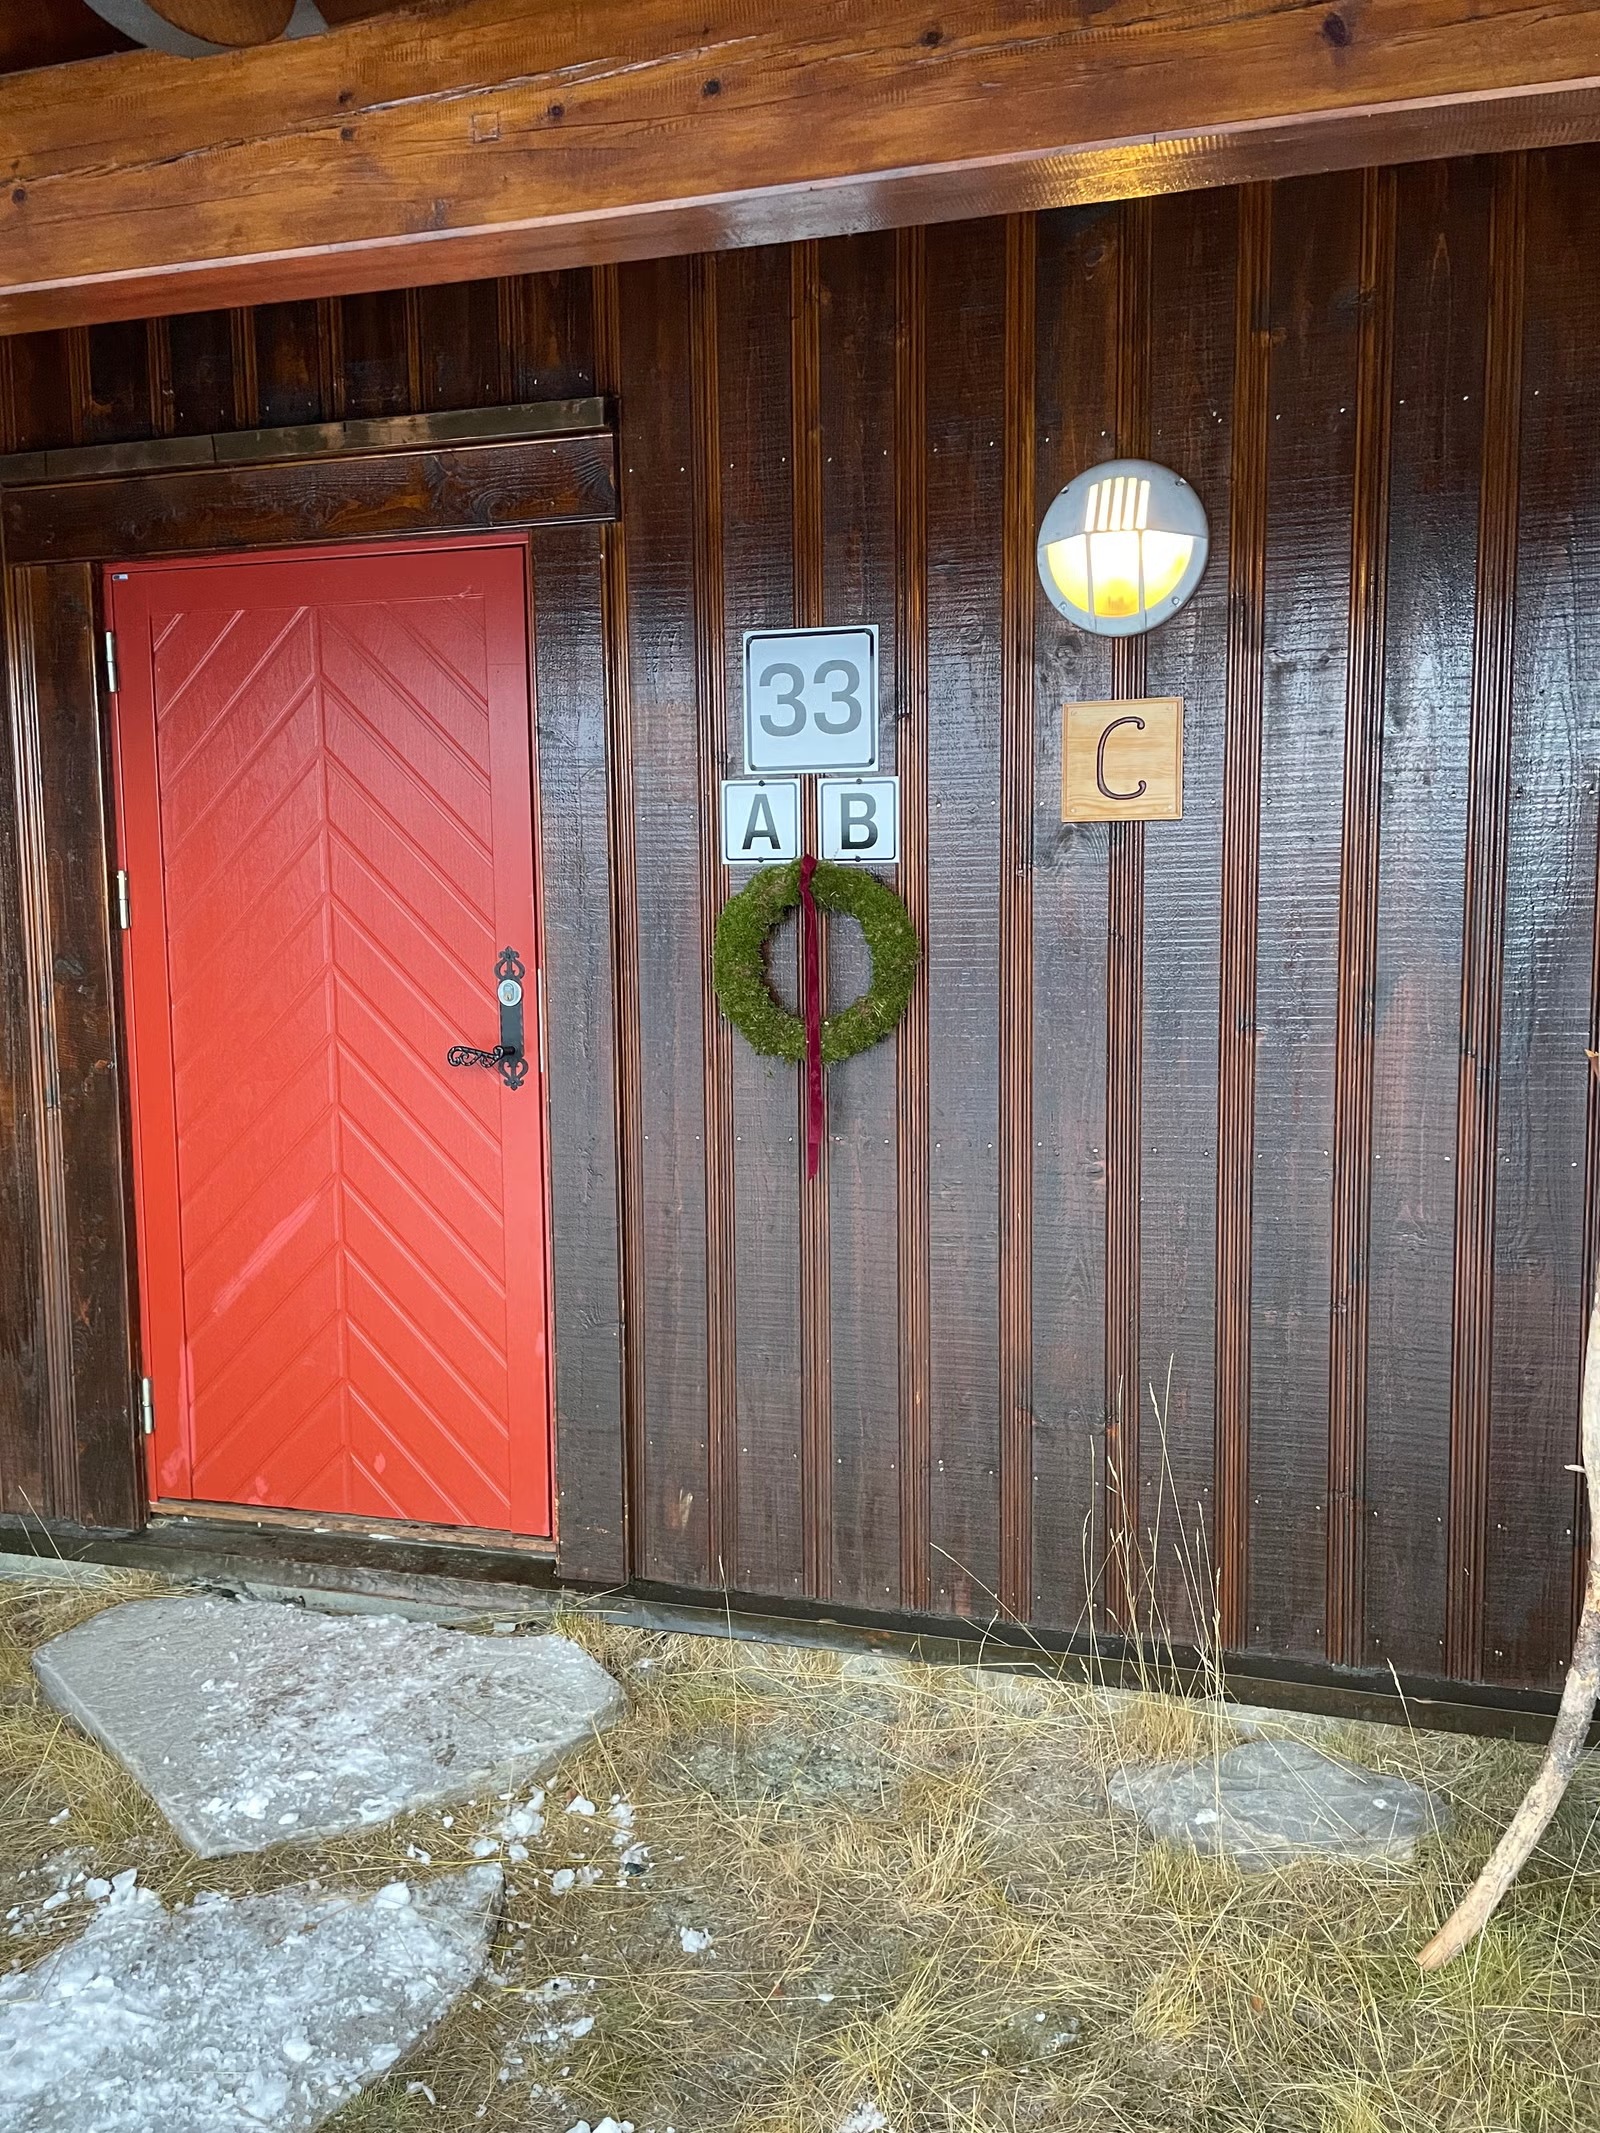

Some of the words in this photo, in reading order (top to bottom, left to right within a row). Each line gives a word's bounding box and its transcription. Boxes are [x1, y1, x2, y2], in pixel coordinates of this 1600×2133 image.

[759, 659, 862, 736] 33
[1096, 716, 1147, 801] C
[741, 793, 782, 850] A
[840, 793, 879, 850] B
